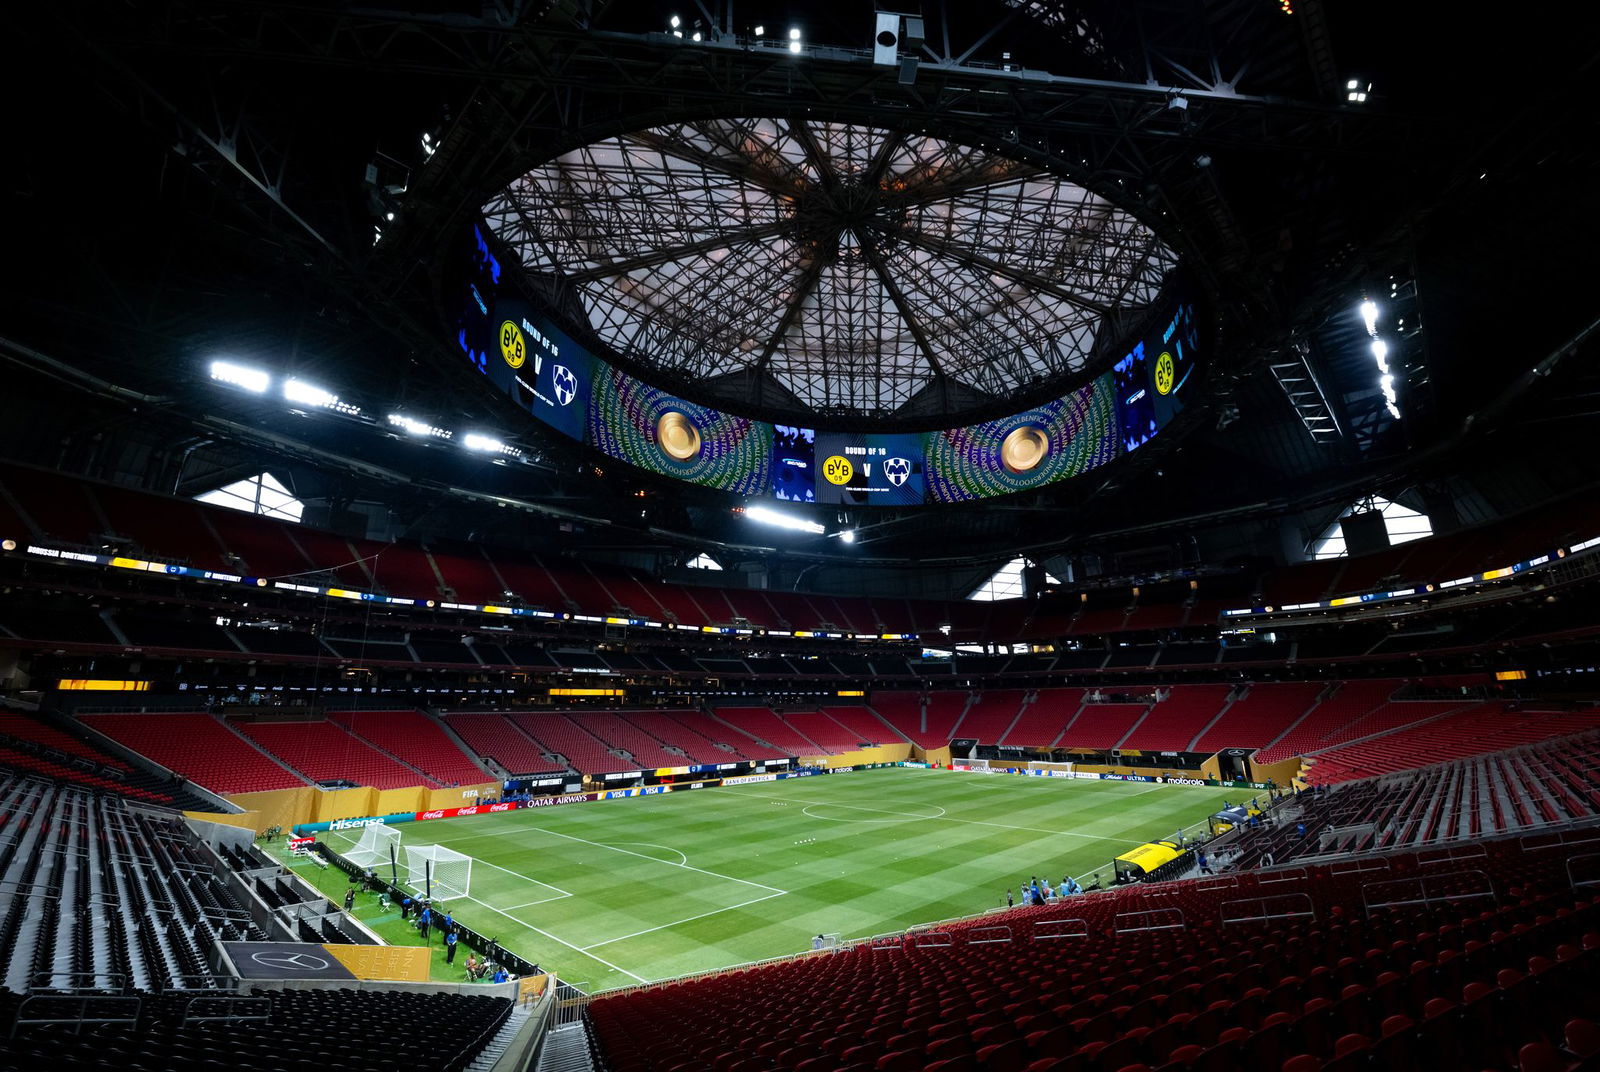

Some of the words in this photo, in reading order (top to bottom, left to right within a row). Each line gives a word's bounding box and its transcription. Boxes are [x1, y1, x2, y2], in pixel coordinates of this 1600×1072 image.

[503, 326, 523, 359] BVB
[522, 317, 541, 342] ROUND
[542, 336, 550, 350] OF
[551, 344, 559, 357] 16
[534, 353, 543, 375] V
[1158, 357, 1172, 387] BVB
[845, 446, 866, 455] ROUND
[868, 447, 876, 455] OF
[878, 447, 887, 456] 16
[828, 459, 849, 476] BVB
[863, 463, 871, 477] V
[1167, 776, 1204, 786] motorola
[462, 790, 478, 799] FIFA
[611, 790, 625, 798] VISA
[645, 786, 658, 794] VISA
[527, 799, 554, 808] QATAR
[556, 795, 587, 805] AIRWAYS
[329, 817, 384, 831] Hisense
